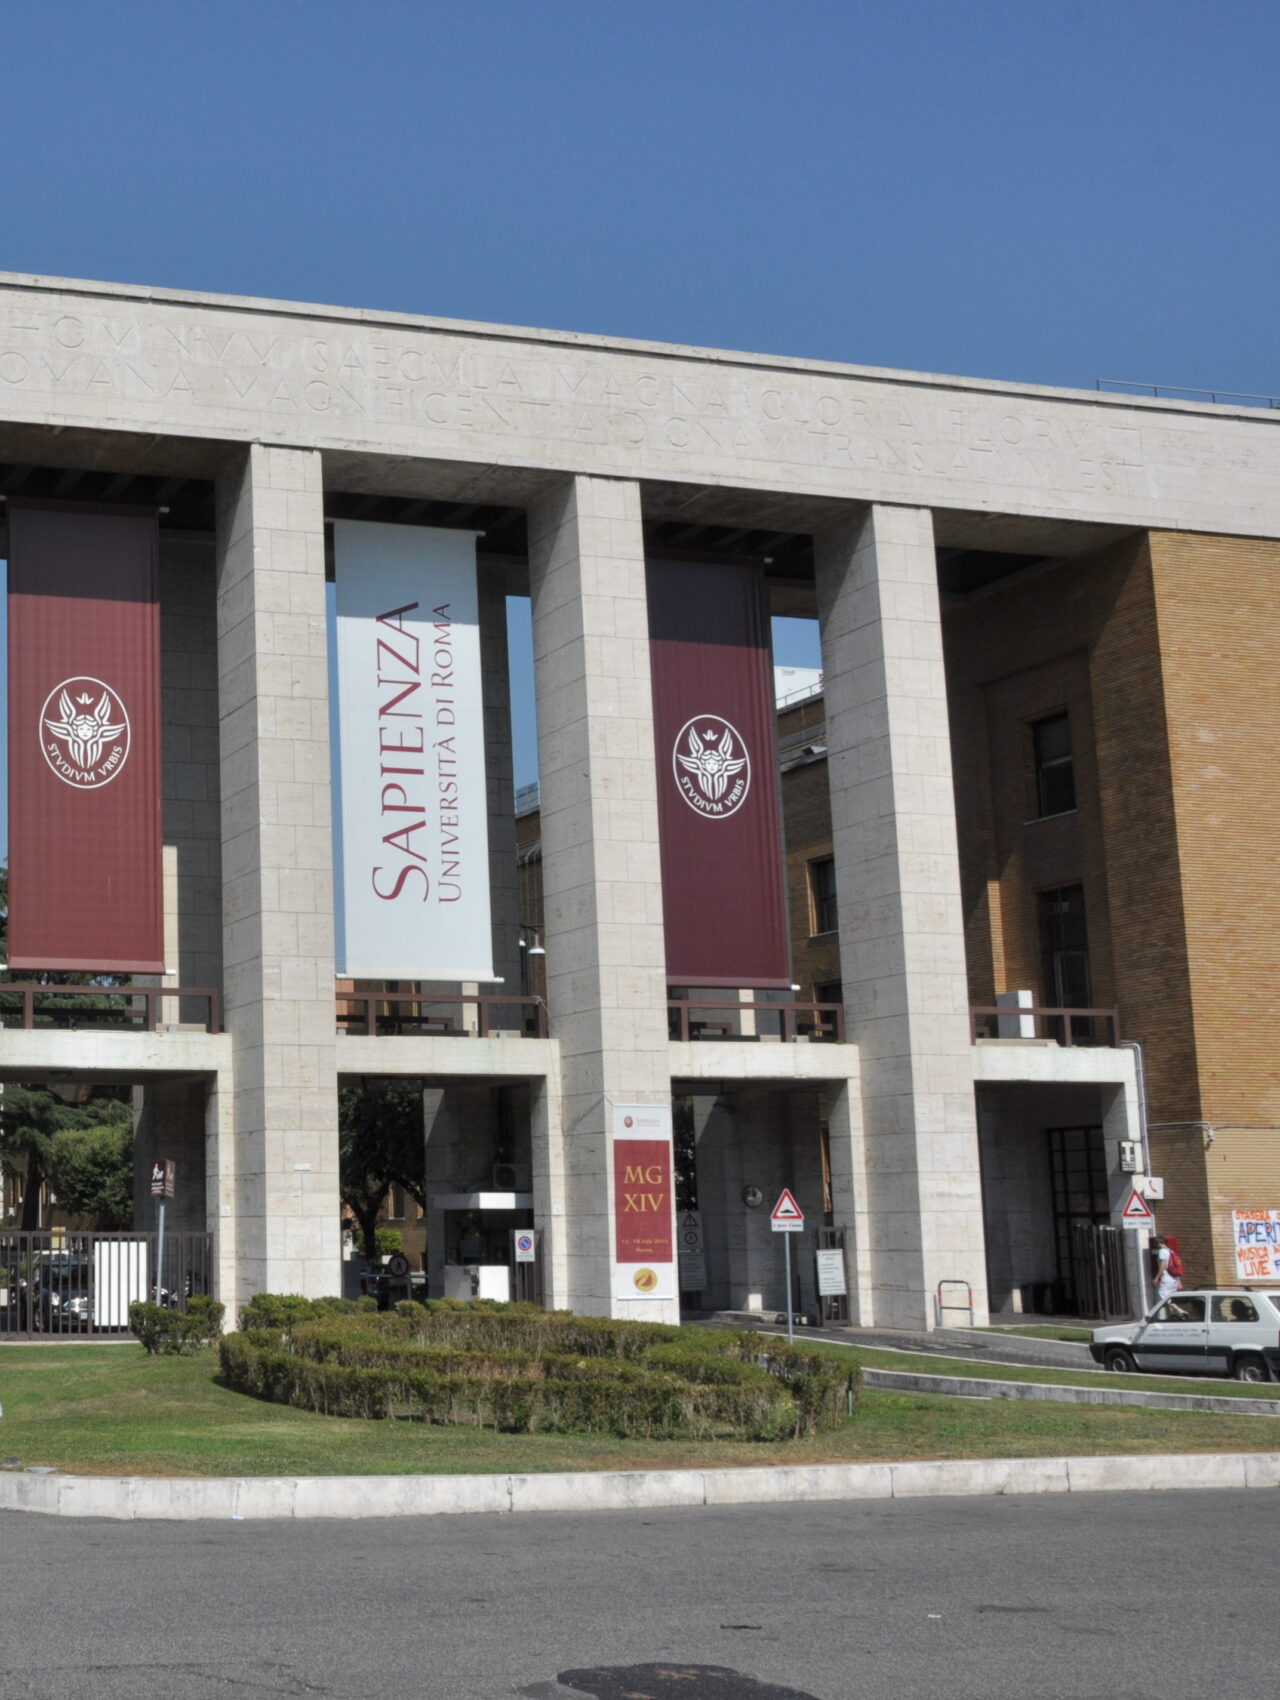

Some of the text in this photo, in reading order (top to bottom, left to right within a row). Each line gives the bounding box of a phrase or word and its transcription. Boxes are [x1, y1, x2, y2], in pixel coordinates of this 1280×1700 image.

[10, 311, 284, 365] HOMINVM
[315, 339, 524, 392] SAECVLA
[555, 368, 730, 413] MAGNA
[761, 389, 918, 432] GLORIA
[947, 408, 1139, 455] FLORVIT
[807, 431, 1060, 481] TRANSLATVM
[1079, 459, 1144, 492] EST
[47, 743, 123, 783] STVDIVM VRBIS
[372, 601, 430, 903] SAPIENZA
[430, 602, 463, 905] UNIVERSITÀ DI ROMA
[680, 776, 745, 813] STVDIVM VRBIS
[623, 1165, 664, 1184] MG
[623, 1194, 664, 1212] XIV
[1235, 1209, 1271, 1221] STASERA
[1237, 1246, 1269, 1262] MUSICA
[1243, 1260, 1271, 1277] LIVE
